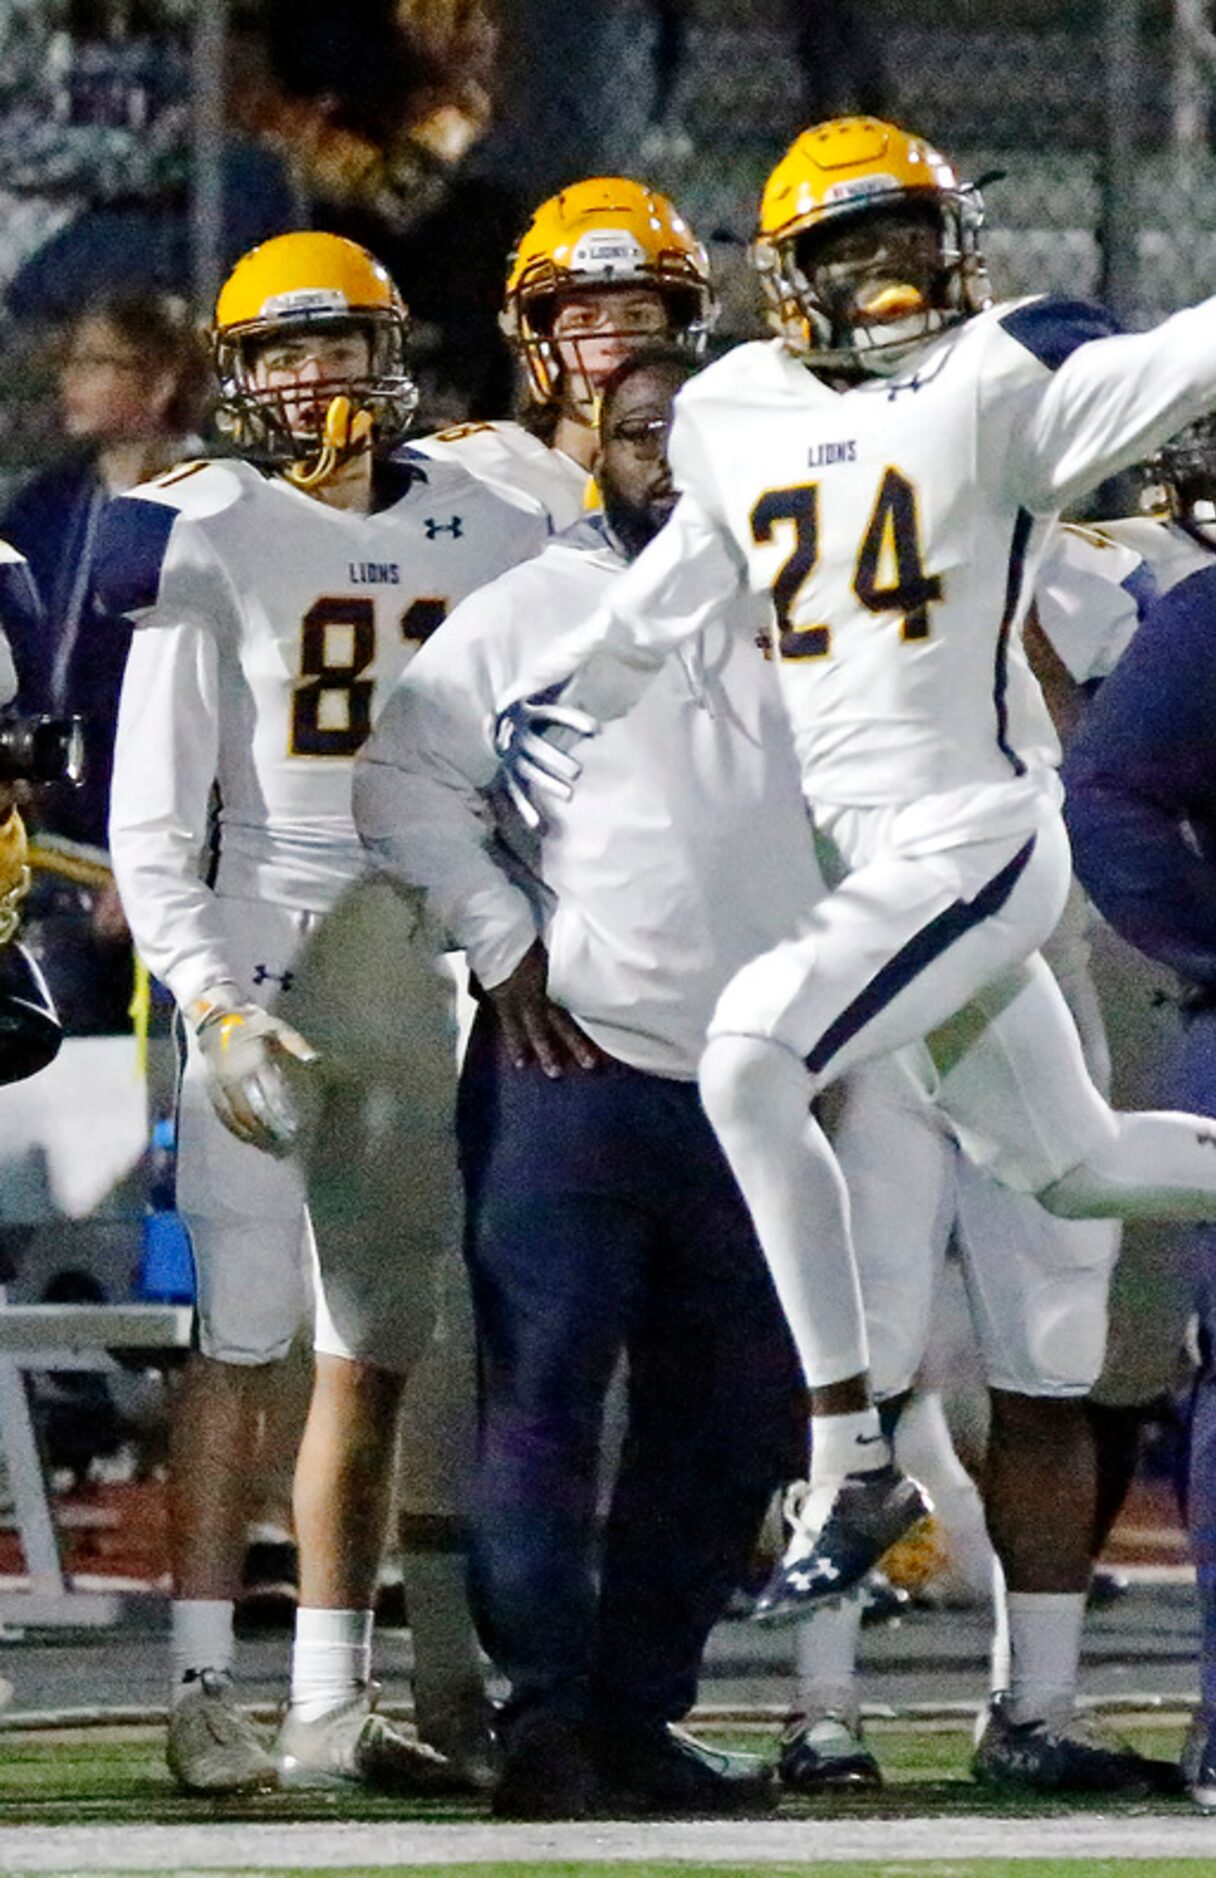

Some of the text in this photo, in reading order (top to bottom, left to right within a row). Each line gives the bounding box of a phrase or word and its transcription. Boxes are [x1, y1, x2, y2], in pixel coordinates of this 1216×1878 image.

[808, 440, 856, 467] LIONS
[350, 562, 400, 584] LIONS
[749, 464, 943, 662] 24
[288, 596, 450, 757] 8
